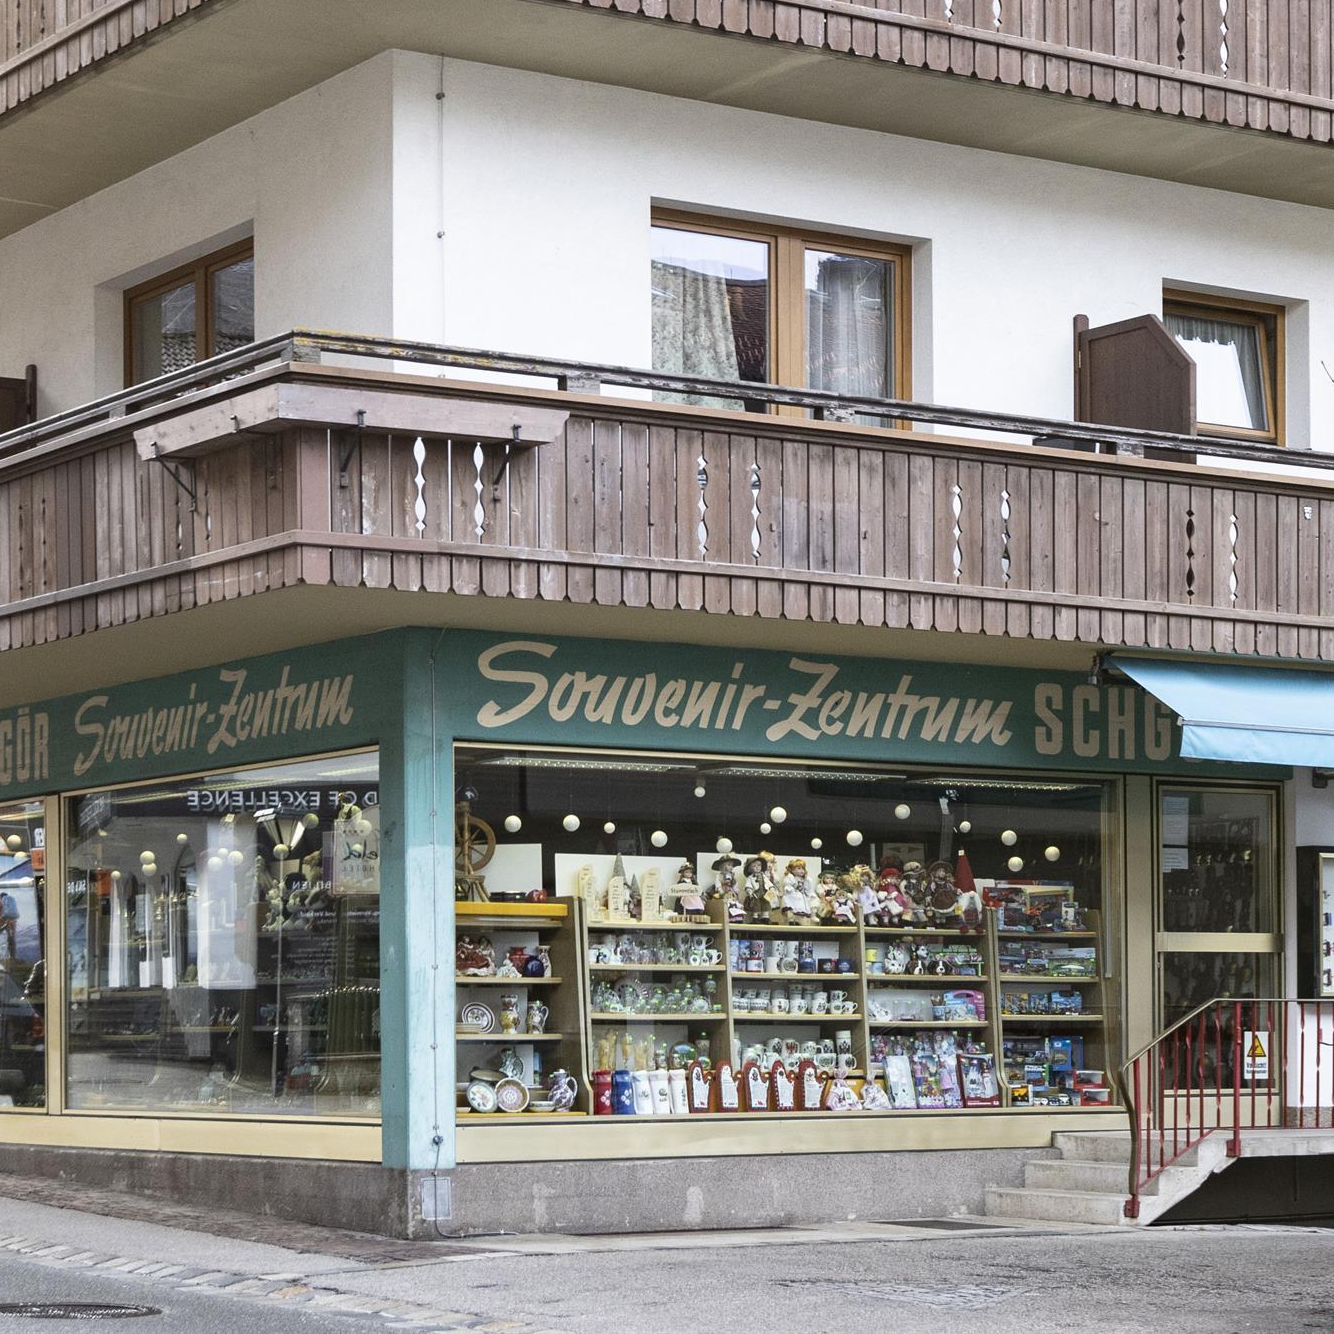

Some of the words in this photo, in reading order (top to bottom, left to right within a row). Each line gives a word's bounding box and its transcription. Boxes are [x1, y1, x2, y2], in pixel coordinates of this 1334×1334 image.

[73, 665, 355, 777] Souvenir-Zentrum
[476, 640, 1013, 747] Souvenir-Zentrum
[1034, 682, 1172, 762] SCHG
